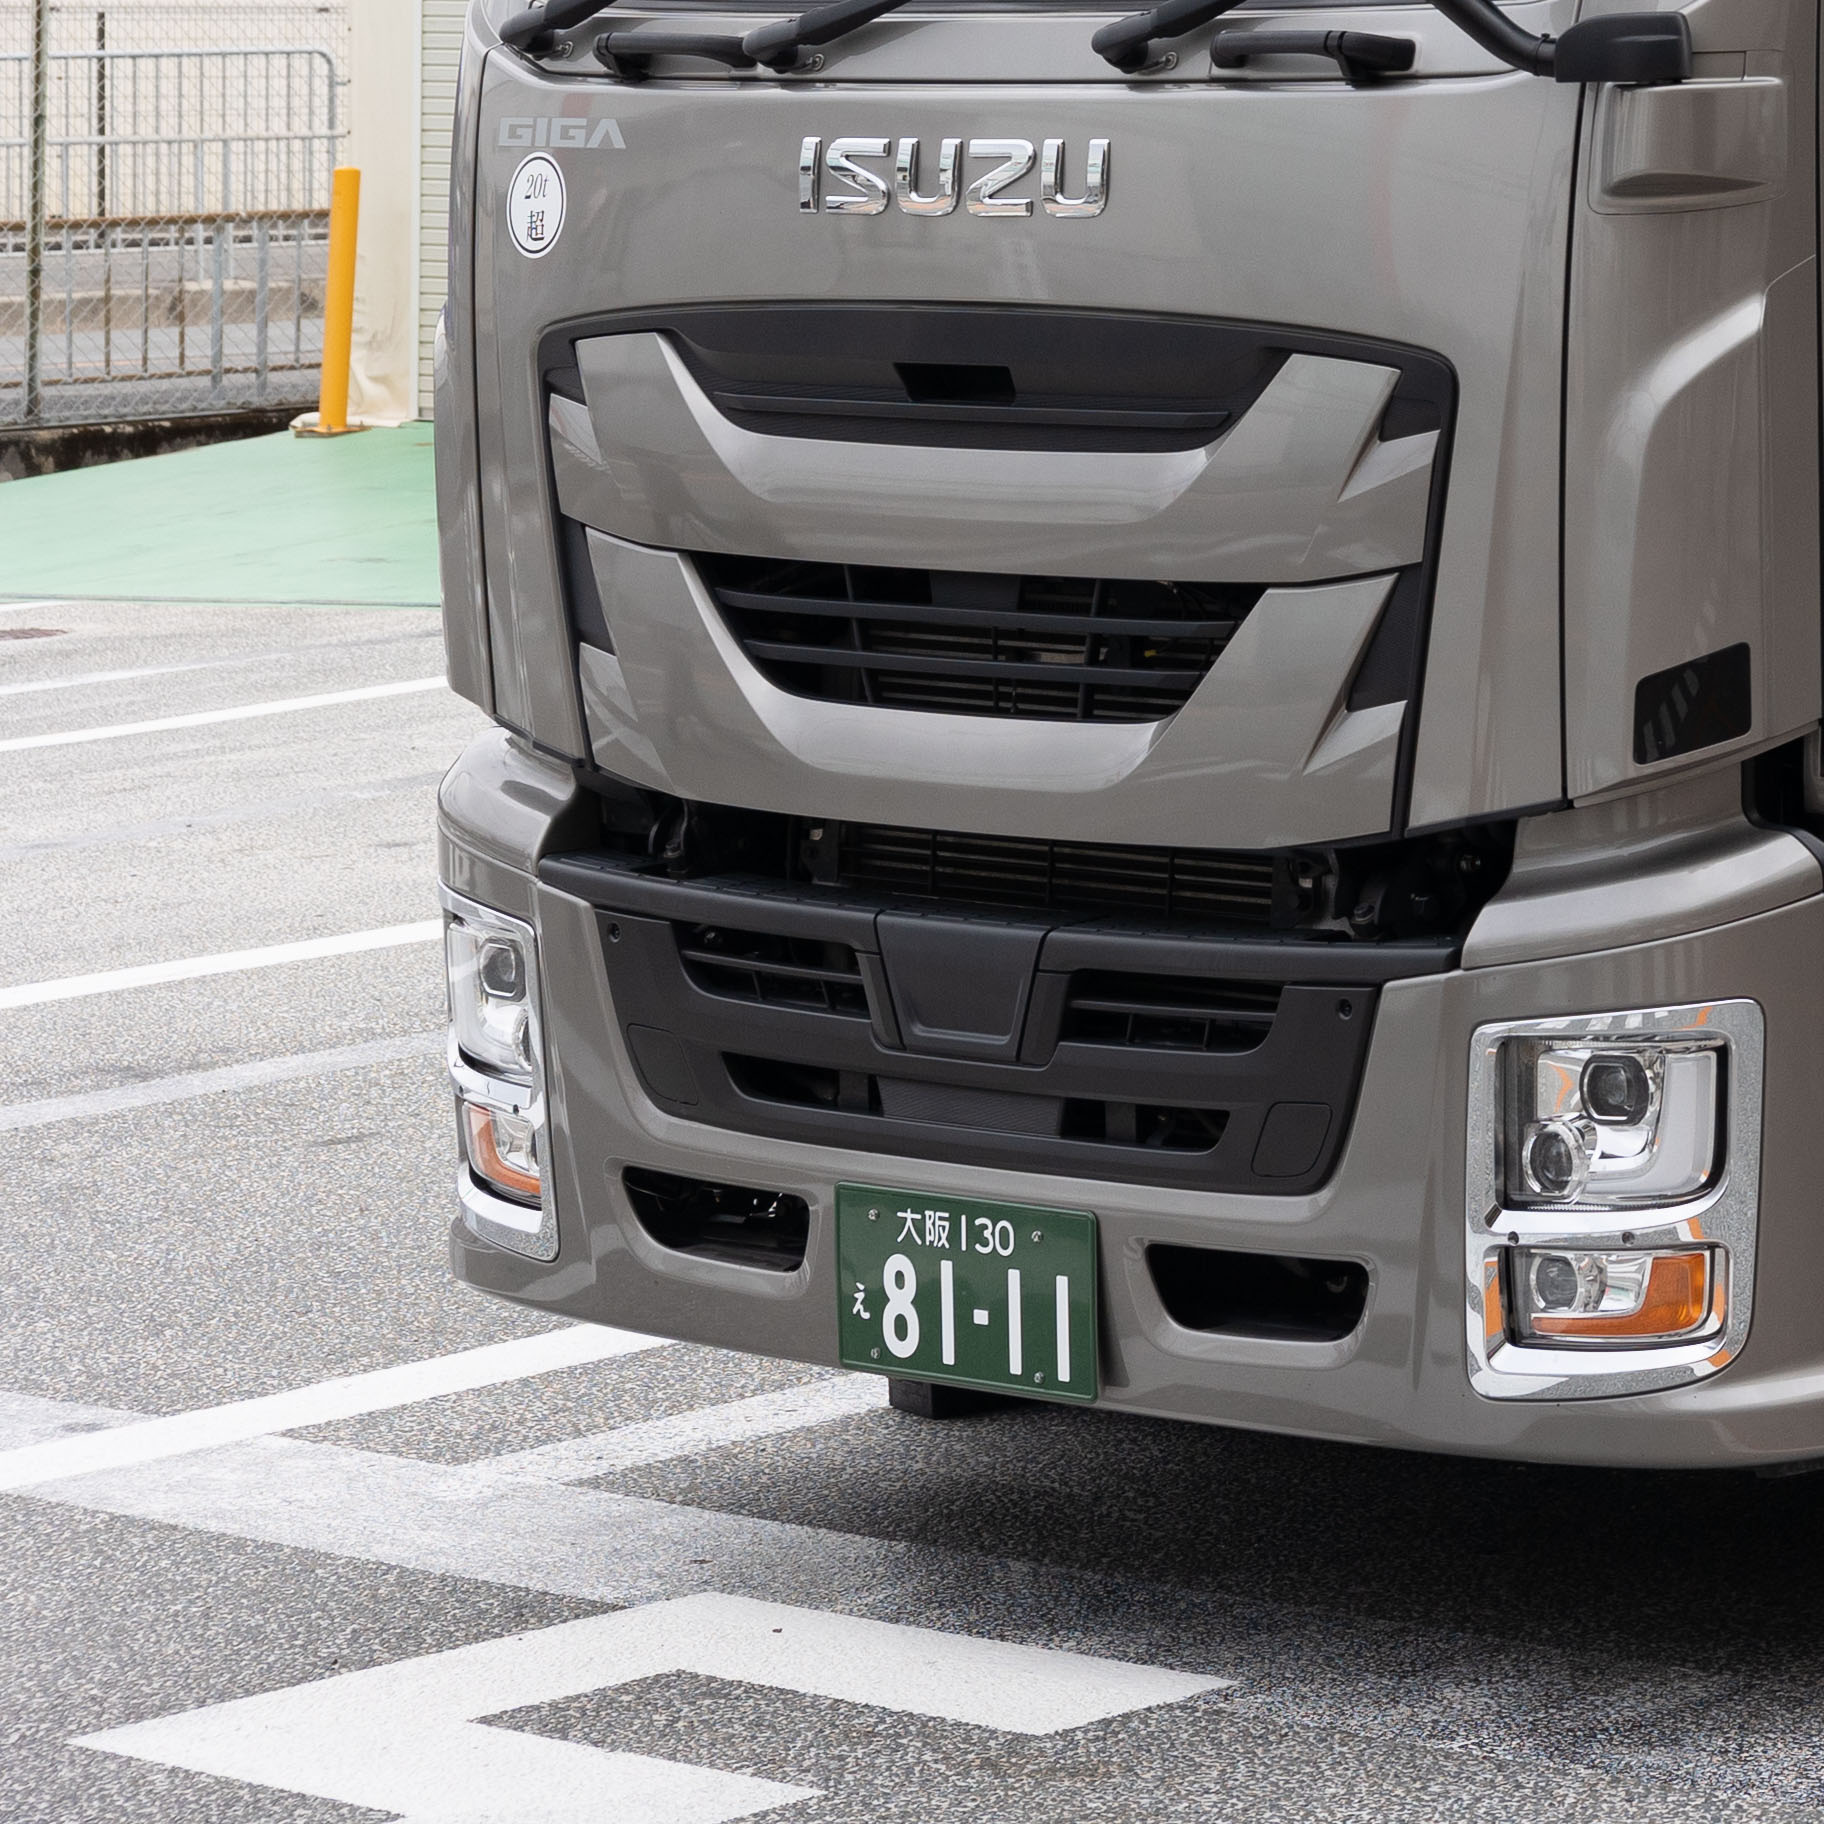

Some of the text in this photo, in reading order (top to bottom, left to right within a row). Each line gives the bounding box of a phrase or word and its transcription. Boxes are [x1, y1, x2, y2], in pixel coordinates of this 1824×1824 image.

[497, 117, 626, 150] GIGA
[524, 173, 550, 199] 20t
[800, 136, 1111, 218] ISUZU
[896, 1207, 1015, 1257] 大阪 130
[852, 1253, 1071, 1383] え 81-11
